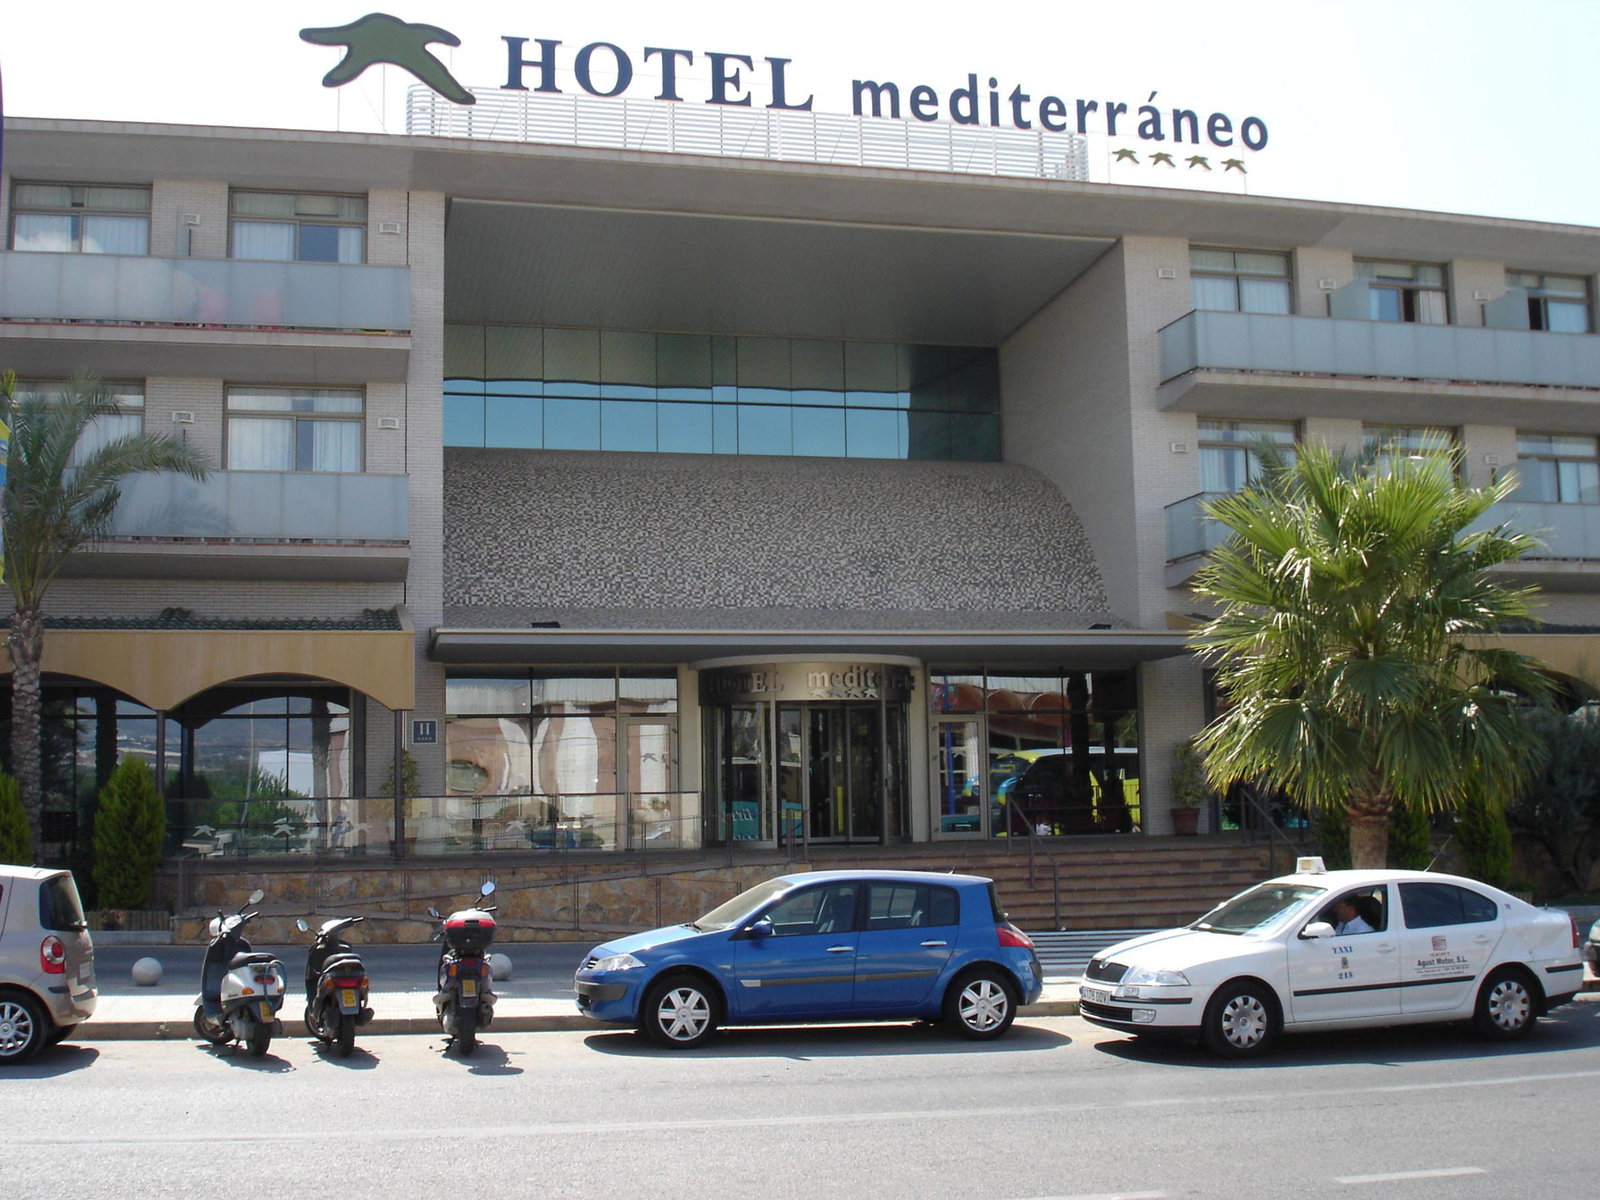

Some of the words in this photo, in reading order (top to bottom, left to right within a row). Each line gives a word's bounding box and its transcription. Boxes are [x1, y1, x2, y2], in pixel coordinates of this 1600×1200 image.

[501, 36, 814, 112] HOTEL
[851, 73, 1269, 152] mediterráneo
[1332, 945, 1353, 955] TAXI
